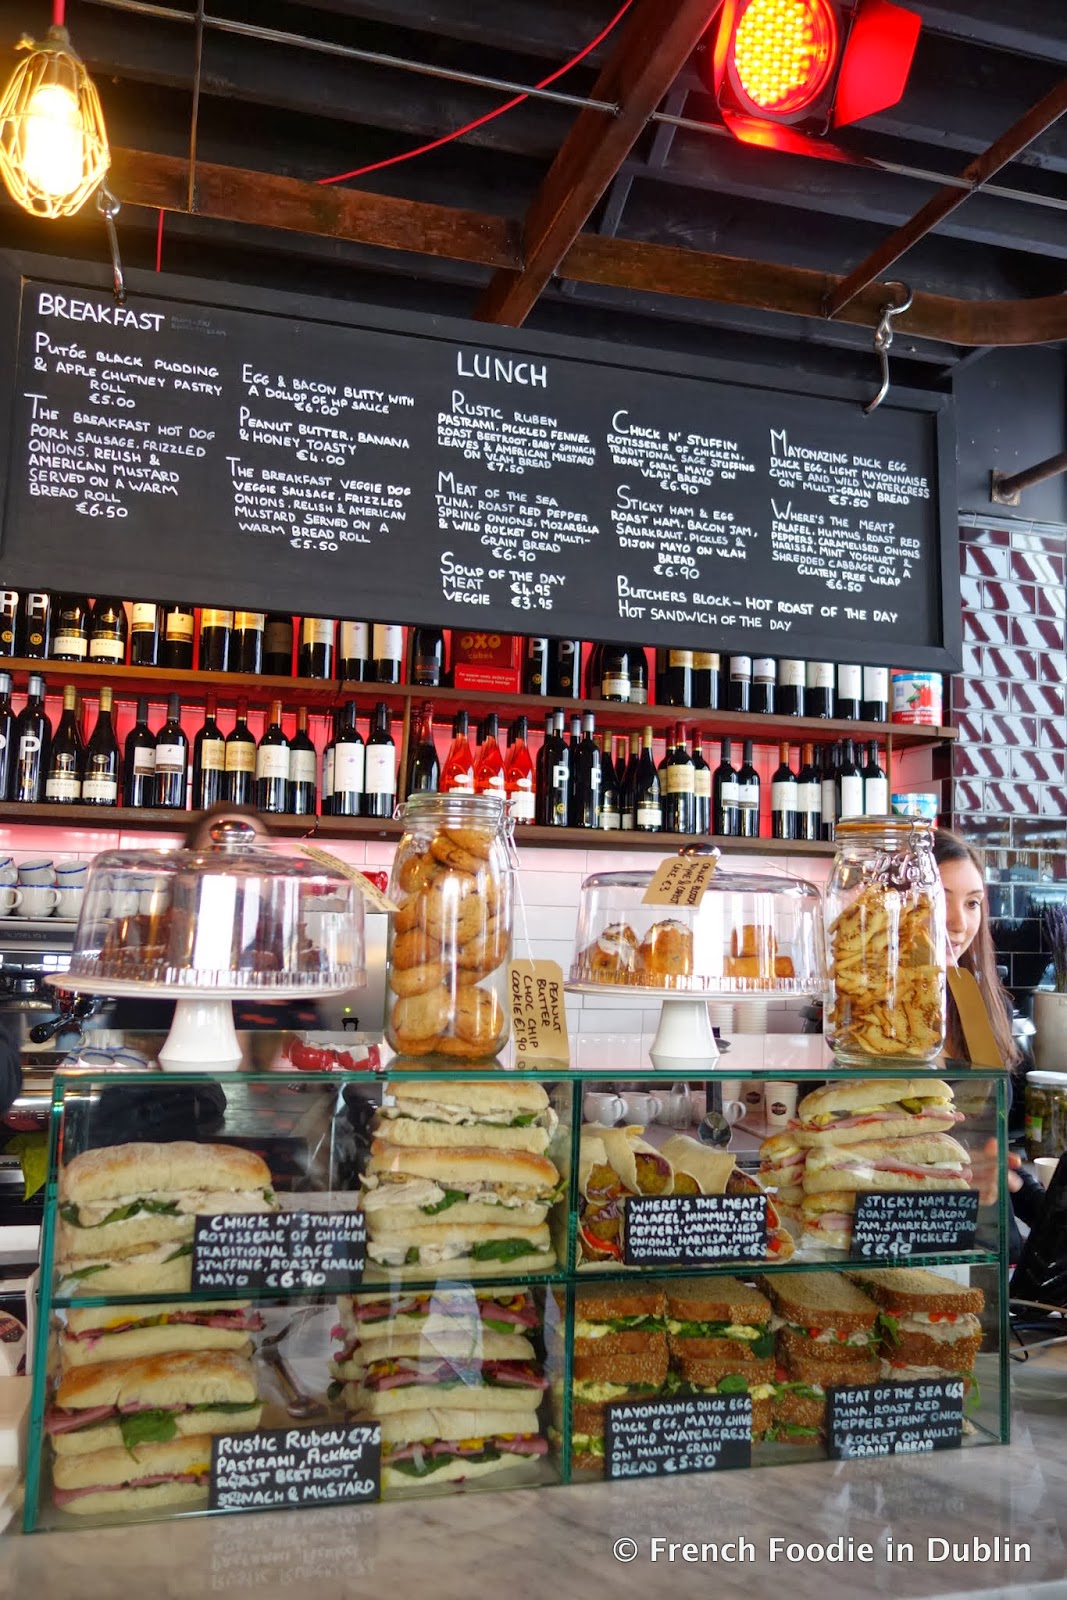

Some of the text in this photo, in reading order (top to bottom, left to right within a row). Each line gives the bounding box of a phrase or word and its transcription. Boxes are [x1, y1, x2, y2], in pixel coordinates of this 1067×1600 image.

[38, 293, 165, 332] BREAKFAST
[96, 351, 143, 367] BLACK
[155, 359, 219, 377] PUDDING
[457, 351, 547, 388] LUNCH
[34, 357, 223, 396] & APPLE CHUTNEY PASTRY
[90, 380, 126, 394] ROLL
[242, 364, 414, 407] EGG & BACON BUTTY WITH
[89, 394, 135, 408] €5.00
[248, 385, 390, 414] A DOLLOP OF HP SAUCE
[294, 402, 339, 416] €6.00
[452, 390, 557, 427] RUSTIC RUBEN
[24, 393, 216, 440] THE BREAKFAST HOT DOG
[240, 406, 293, 432] PEANUT
[358, 432, 410, 449] BANANA
[30, 424, 69, 440] PORK
[143, 440, 206, 457] FRIZZLED
[612, 410, 660, 439] CHUCK
[687, 435, 737, 451] STUFFIN
[239, 429, 357, 455] & HONEY TOASTY
[770, 429, 907, 472] MAYONAZING DUCK EGG
[94, 447, 141, 462] RELISH
[149, 454, 160, 466] &
[296, 450, 345, 465] €4.00
[28, 454, 179, 482] AMERICAN MUSTARD
[226, 456, 411, 496] THE BREAKFAST VEGGIE DOG
[487, 463, 524, 474] €7.50
[29, 468, 178, 496] SERVED ON A WARM
[30, 483, 121, 503] BREAD ROLL
[437, 471, 558, 506] MEAT OF THE SEA
[76, 502, 128, 518] €6.50
[617, 484, 734, 521] STICKY HAM & EGG
[828, 495, 869, 508] €5.50
[771, 498, 895, 534] WHERE'S THE MEAT?
[238, 522, 371, 544] WARM BREAD ROLL
[290, 539, 338, 551] €5.50
[492, 548, 536, 562] €6.90
[440, 551, 566, 585] SOUP OF THE DAY
[653, 565, 700, 579] €6.90
[442, 575, 551, 597] MEAT €4.95
[826, 579, 862, 592] €6.50
[443, 589, 553, 610] VEGGIE €3.95
[617, 575, 687, 603] BUTCHERS
[745, 597, 773, 611] HOT
[777, 602, 814, 616] ROAST
[821, 606, 838, 617] OF
[844, 607, 867, 621] THE
[873, 609, 898, 623] DAY
[618, 600, 791, 632] HOT SANDWICH OF THE DAY
[460, 634, 501, 650] OXO
[20, 736, 41, 760] P
[553, 765, 569, 787] P
[512, 970, 523, 1015] COOKIE
[537, 979, 550, 1027] BUTTER
[524, 975, 538, 1048] CHOC CHIP
[549, 982, 561, 1034] PEANUT
[630, 1196, 766, 1212] WHERE'S THE MEAT?
[864, 1196, 914, 1208] STICKY
[919, 1196, 944, 1207] HAM
[948, 1196, 957, 1207] &
[211, 1215, 270, 1231] CHUCK
[300, 1214, 364, 1228] STUFFIN
[196, 1245, 287, 1258] TRADITIONAL
[861, 1242, 912, 1255] €6.90
[271, 1259, 319, 1270] ROAST
[321, 1258, 364, 1270] GARLIC
[200, 1270, 326, 1288] MAYO €6.90
[835, 1385, 942, 1404] MEAT OF THE SEA
[611, 1402, 694, 1420] MAYONAZING
[697, 1400, 725, 1412] DUCK
[612, 1454, 716, 1477] BREAD €5.50
[303, 1479, 375, 1499] MUSTARD
